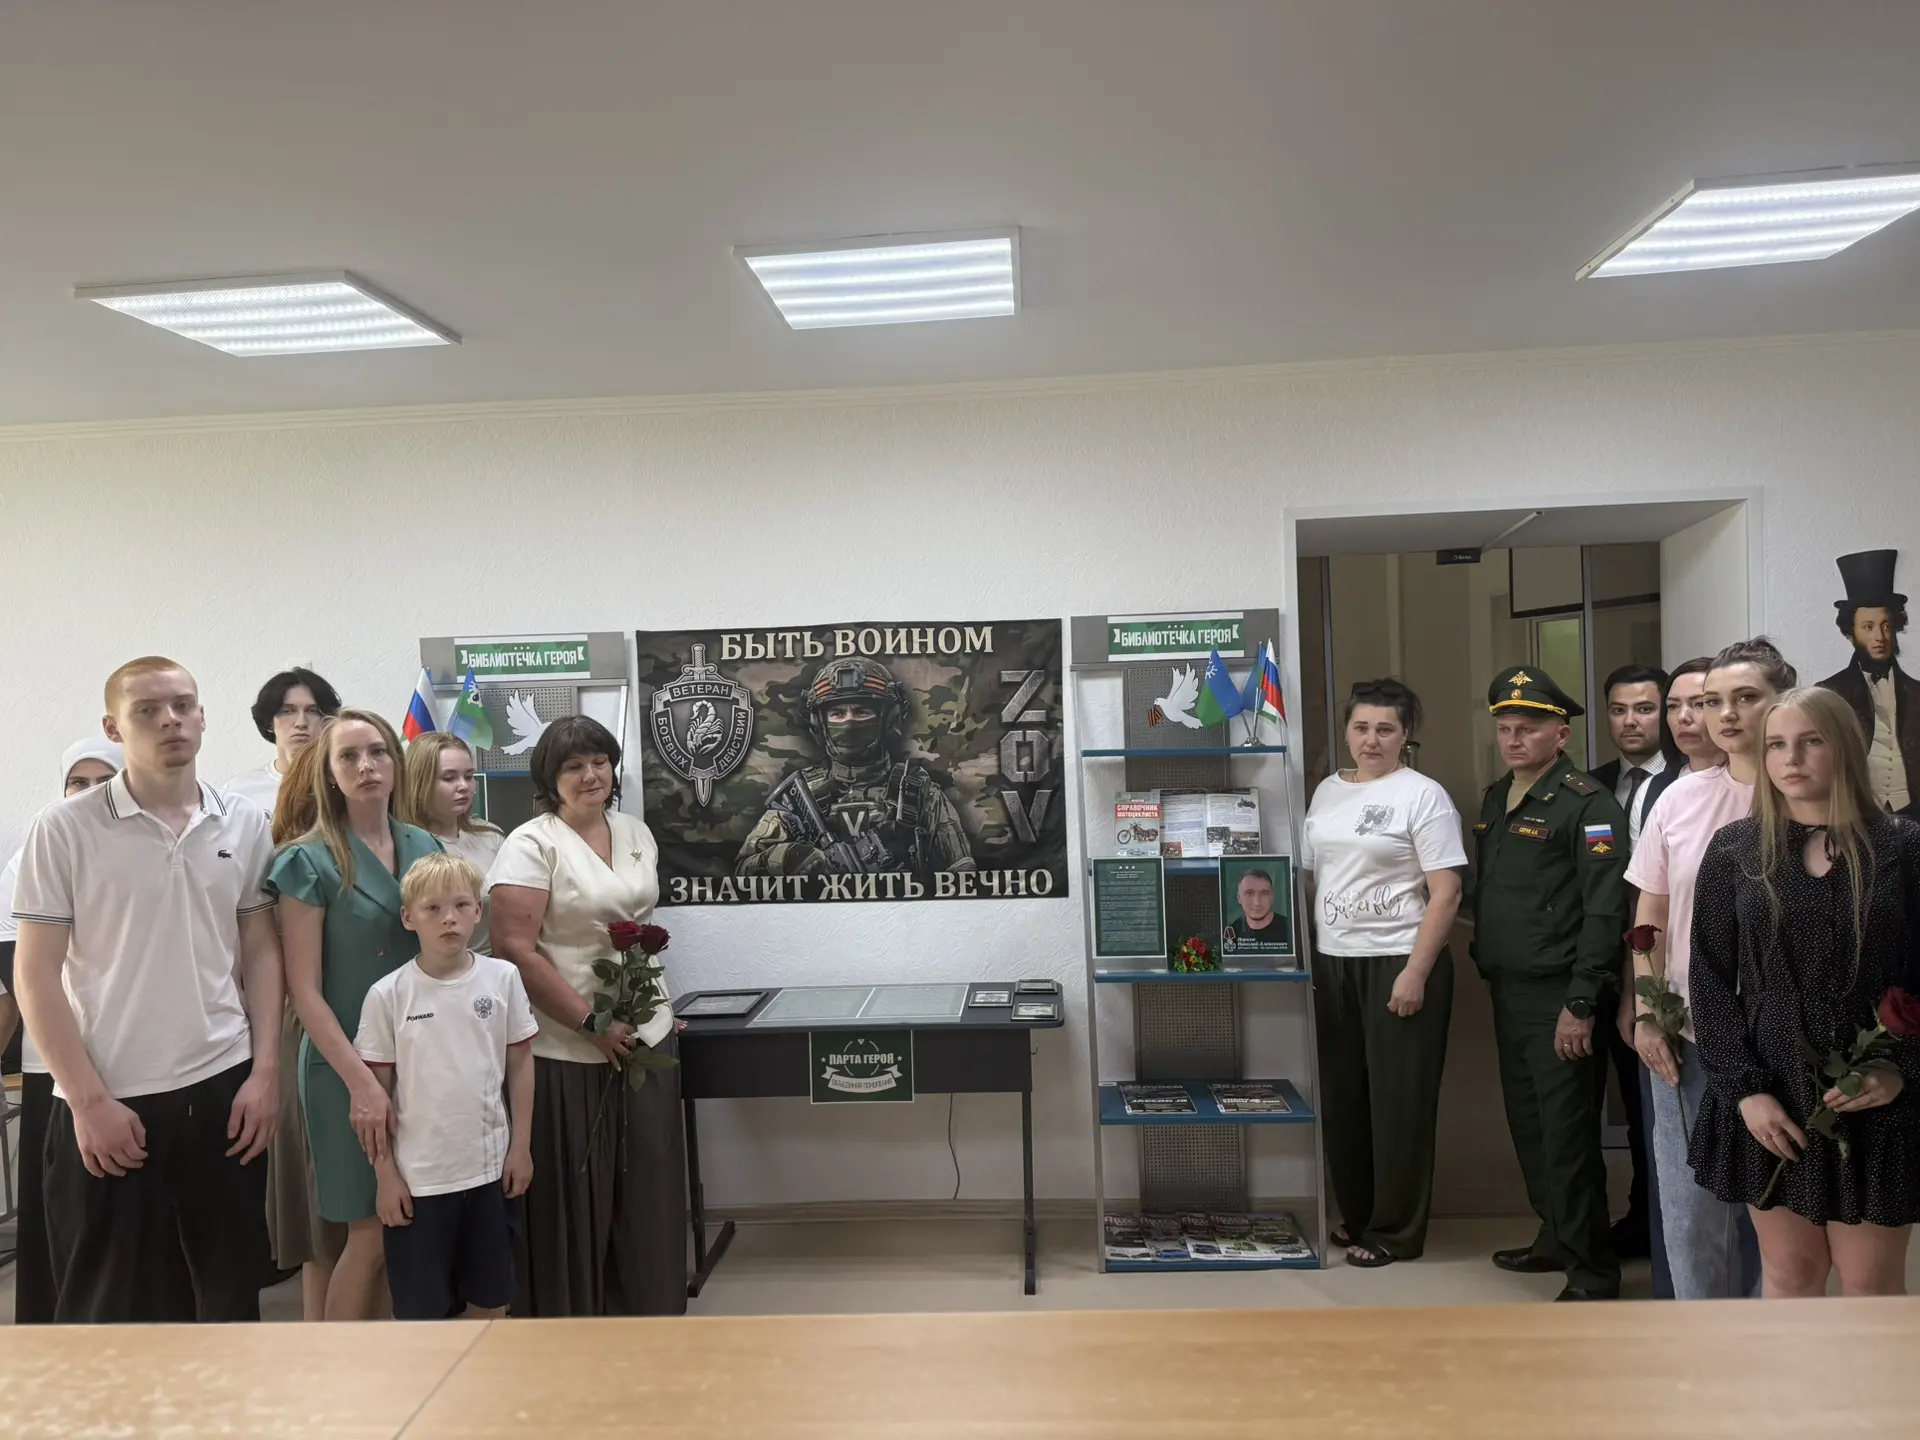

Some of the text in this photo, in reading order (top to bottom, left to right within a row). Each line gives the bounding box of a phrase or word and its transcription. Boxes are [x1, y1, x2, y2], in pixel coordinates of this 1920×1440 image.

[720, 625, 994, 661] БЫТЬ ВОИНОМ
[1121, 628, 1232, 647] БИБЛИОТЕЧКА ГЕРОЯ
[469, 649, 577, 668] БИБЛИОТЕЧКА ГЕРОЯ
[672, 684, 729, 698] ВЕТЕРАН
[657, 717, 689, 769] БОЕВЫХ
[718, 711, 747, 770] ДЕЙСТВИЙ
[841, 811, 866, 839] V
[669, 868, 1054, 904] ЗНАЧИТ ЖИТЬ ВЕЧНО
[829, 1052, 894, 1065] ПАРТА ГЕРОЯ
